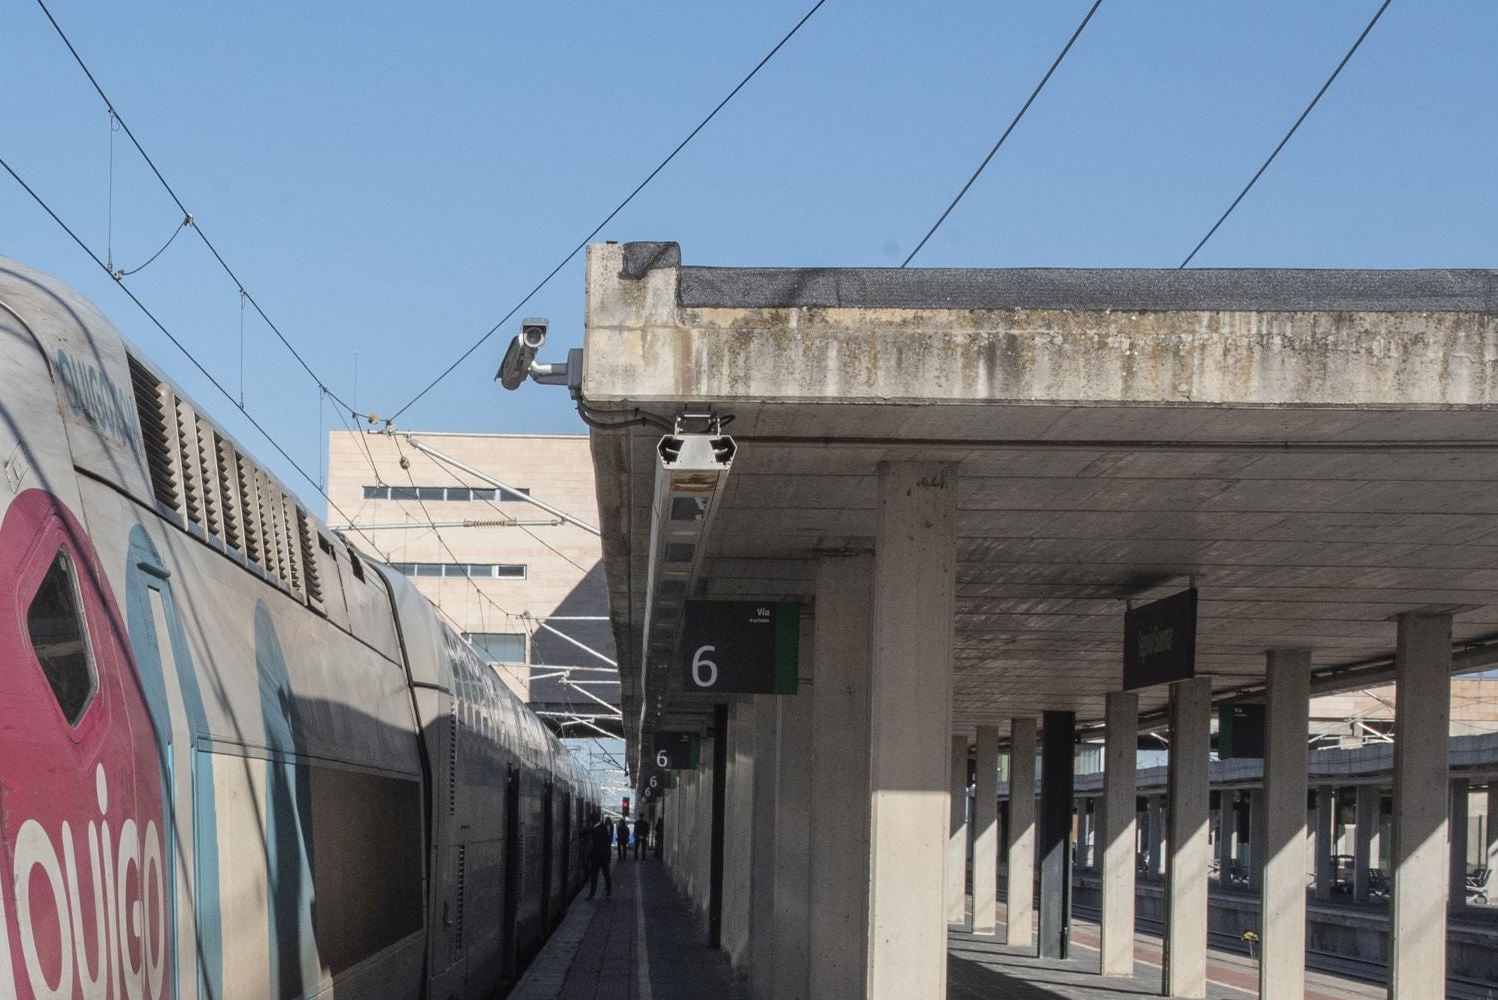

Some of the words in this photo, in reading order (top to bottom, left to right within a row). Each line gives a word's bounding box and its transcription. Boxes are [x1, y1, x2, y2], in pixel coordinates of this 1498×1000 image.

[691, 645, 718, 688] 6
[656, 750, 668, 767] 6
[649, 776, 657, 788] 6
[645, 787, 652, 797] 6
